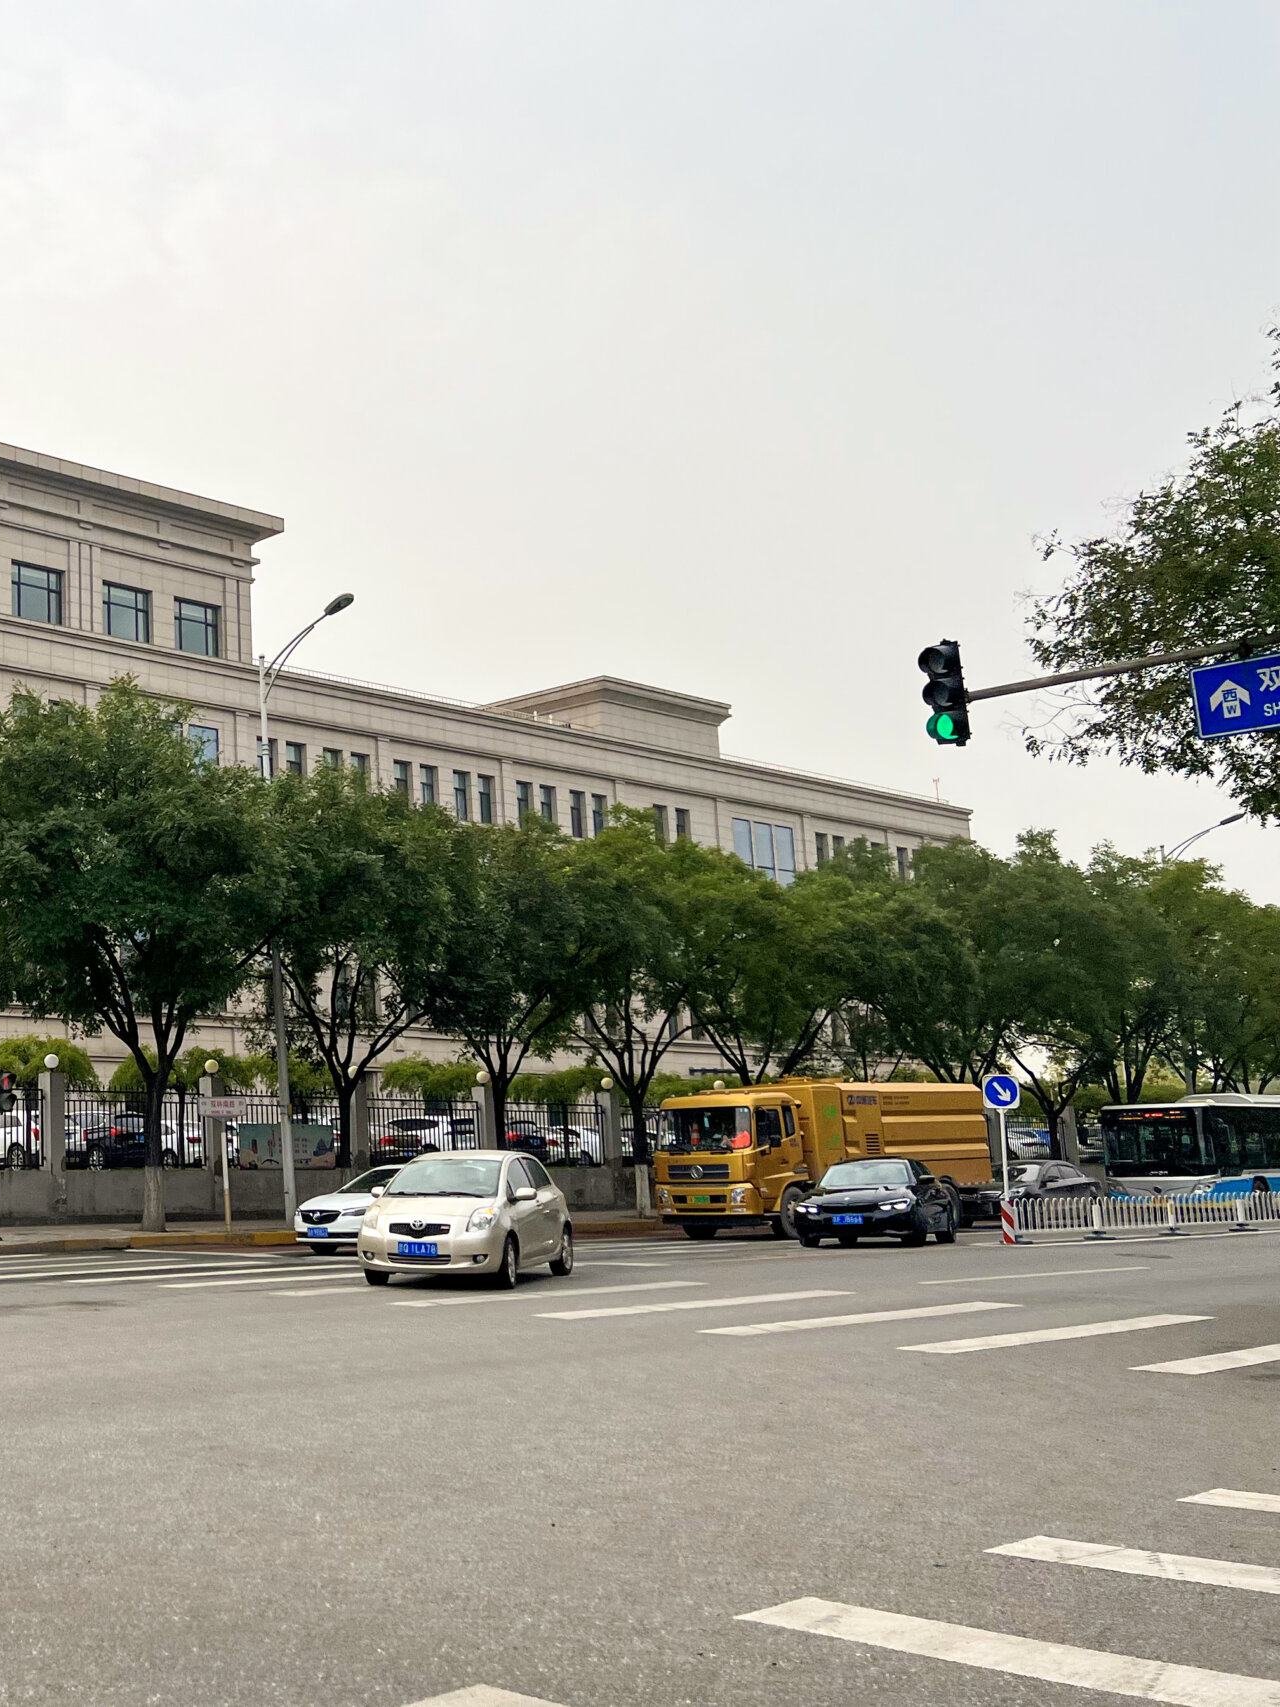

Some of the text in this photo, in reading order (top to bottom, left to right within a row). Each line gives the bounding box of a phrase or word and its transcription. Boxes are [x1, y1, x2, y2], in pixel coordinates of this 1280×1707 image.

[1256, 666, 1280, 692] 双
[1221, 688, 1238, 703] 西
[1226, 704, 1237, 715] W
